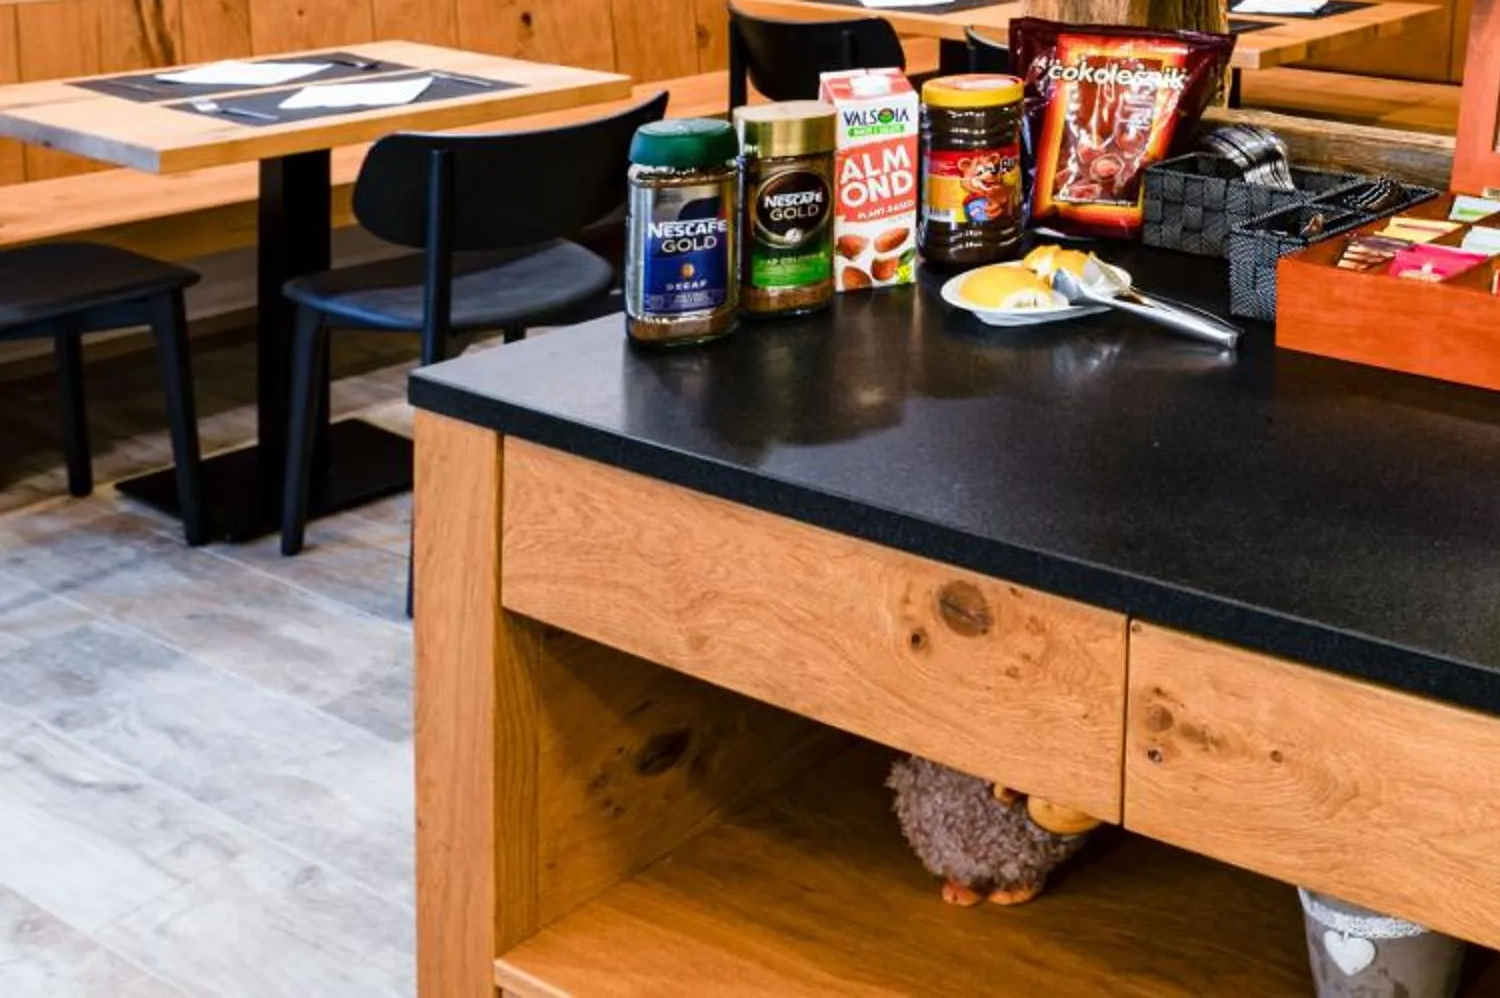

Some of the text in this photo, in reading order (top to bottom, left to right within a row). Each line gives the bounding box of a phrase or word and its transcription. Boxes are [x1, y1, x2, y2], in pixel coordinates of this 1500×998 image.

[839, 144, 912, 184] ALM
[841, 169, 914, 208] OND
[769, 203, 820, 222] GOLD
[661, 235, 718, 253] GOLD
